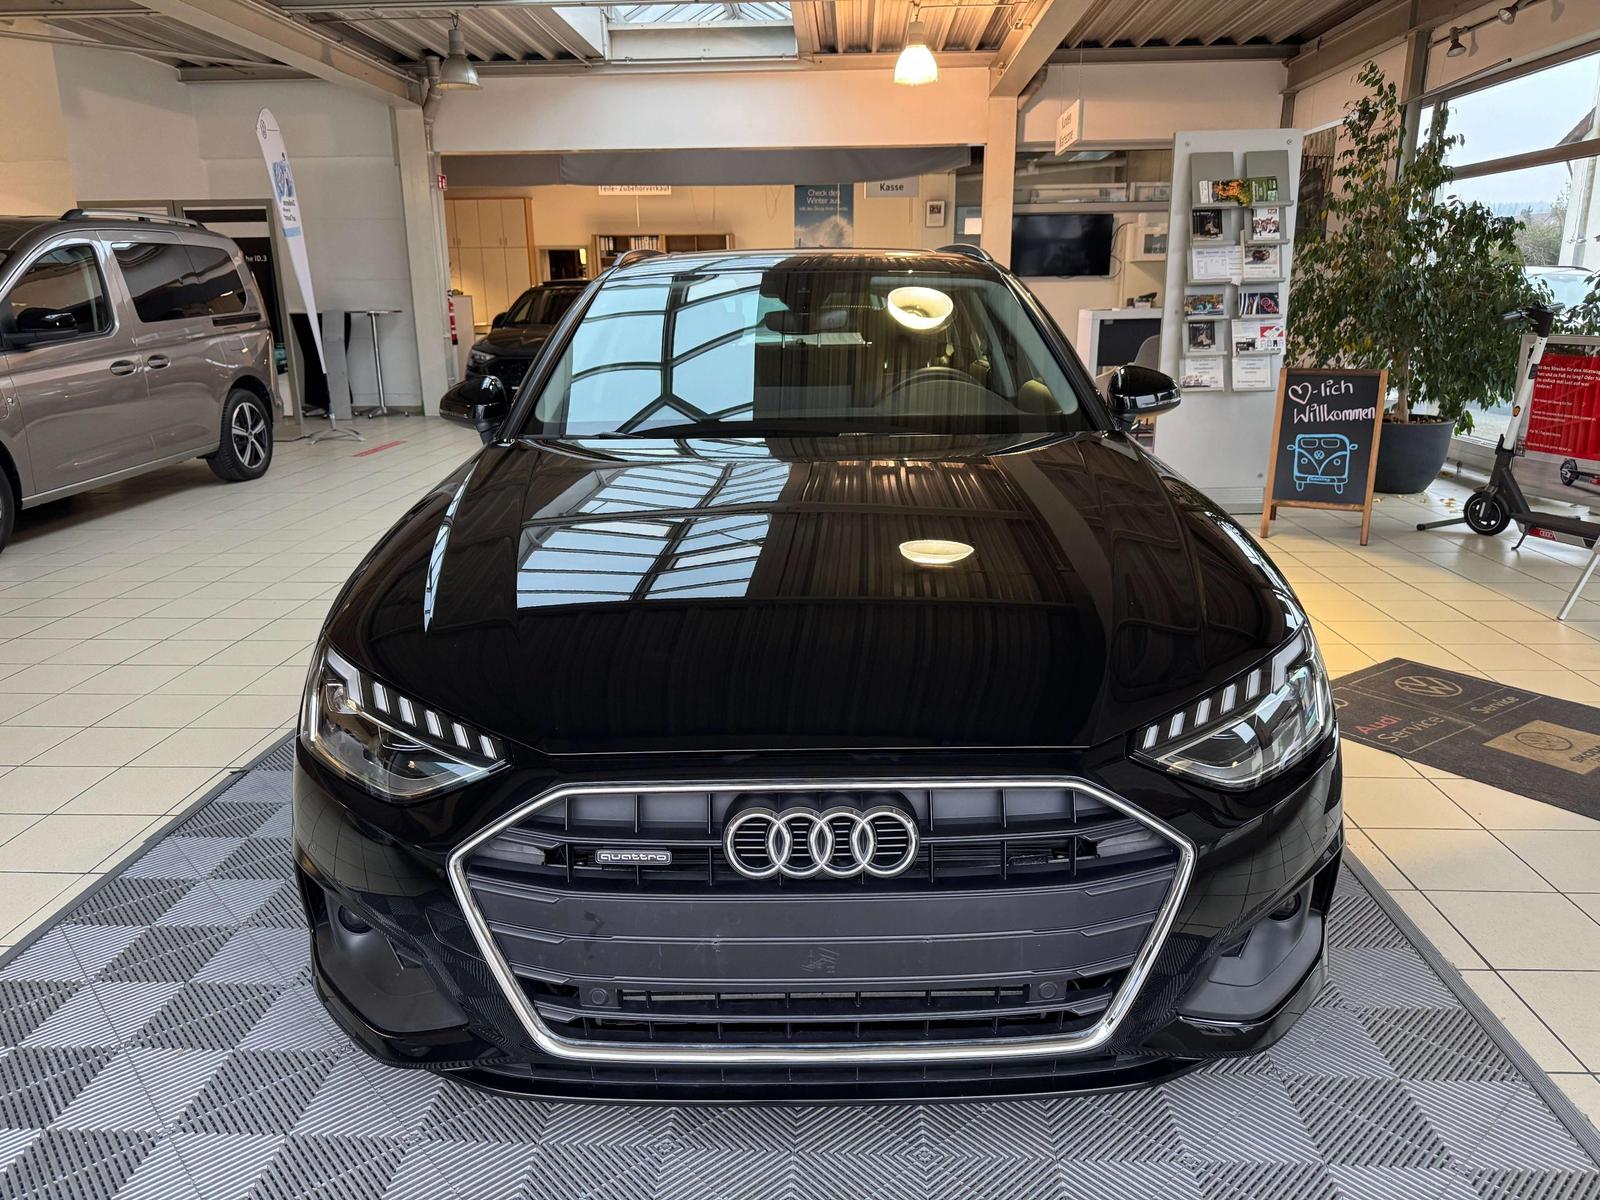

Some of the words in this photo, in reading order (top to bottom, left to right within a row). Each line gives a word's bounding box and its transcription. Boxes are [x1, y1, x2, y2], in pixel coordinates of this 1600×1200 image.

[879, 183, 905, 192] Kasse
[807, 196, 828, 205] Winter
[254, 254, 268, 262] ID.3
[1294, 404, 1375, 424] Willkommen
[1470, 695, 1520, 714] Service
[1356, 714, 1402, 734] Audi
[1377, 715, 1444, 743] Service
[601, 853, 667, 863] quattro
